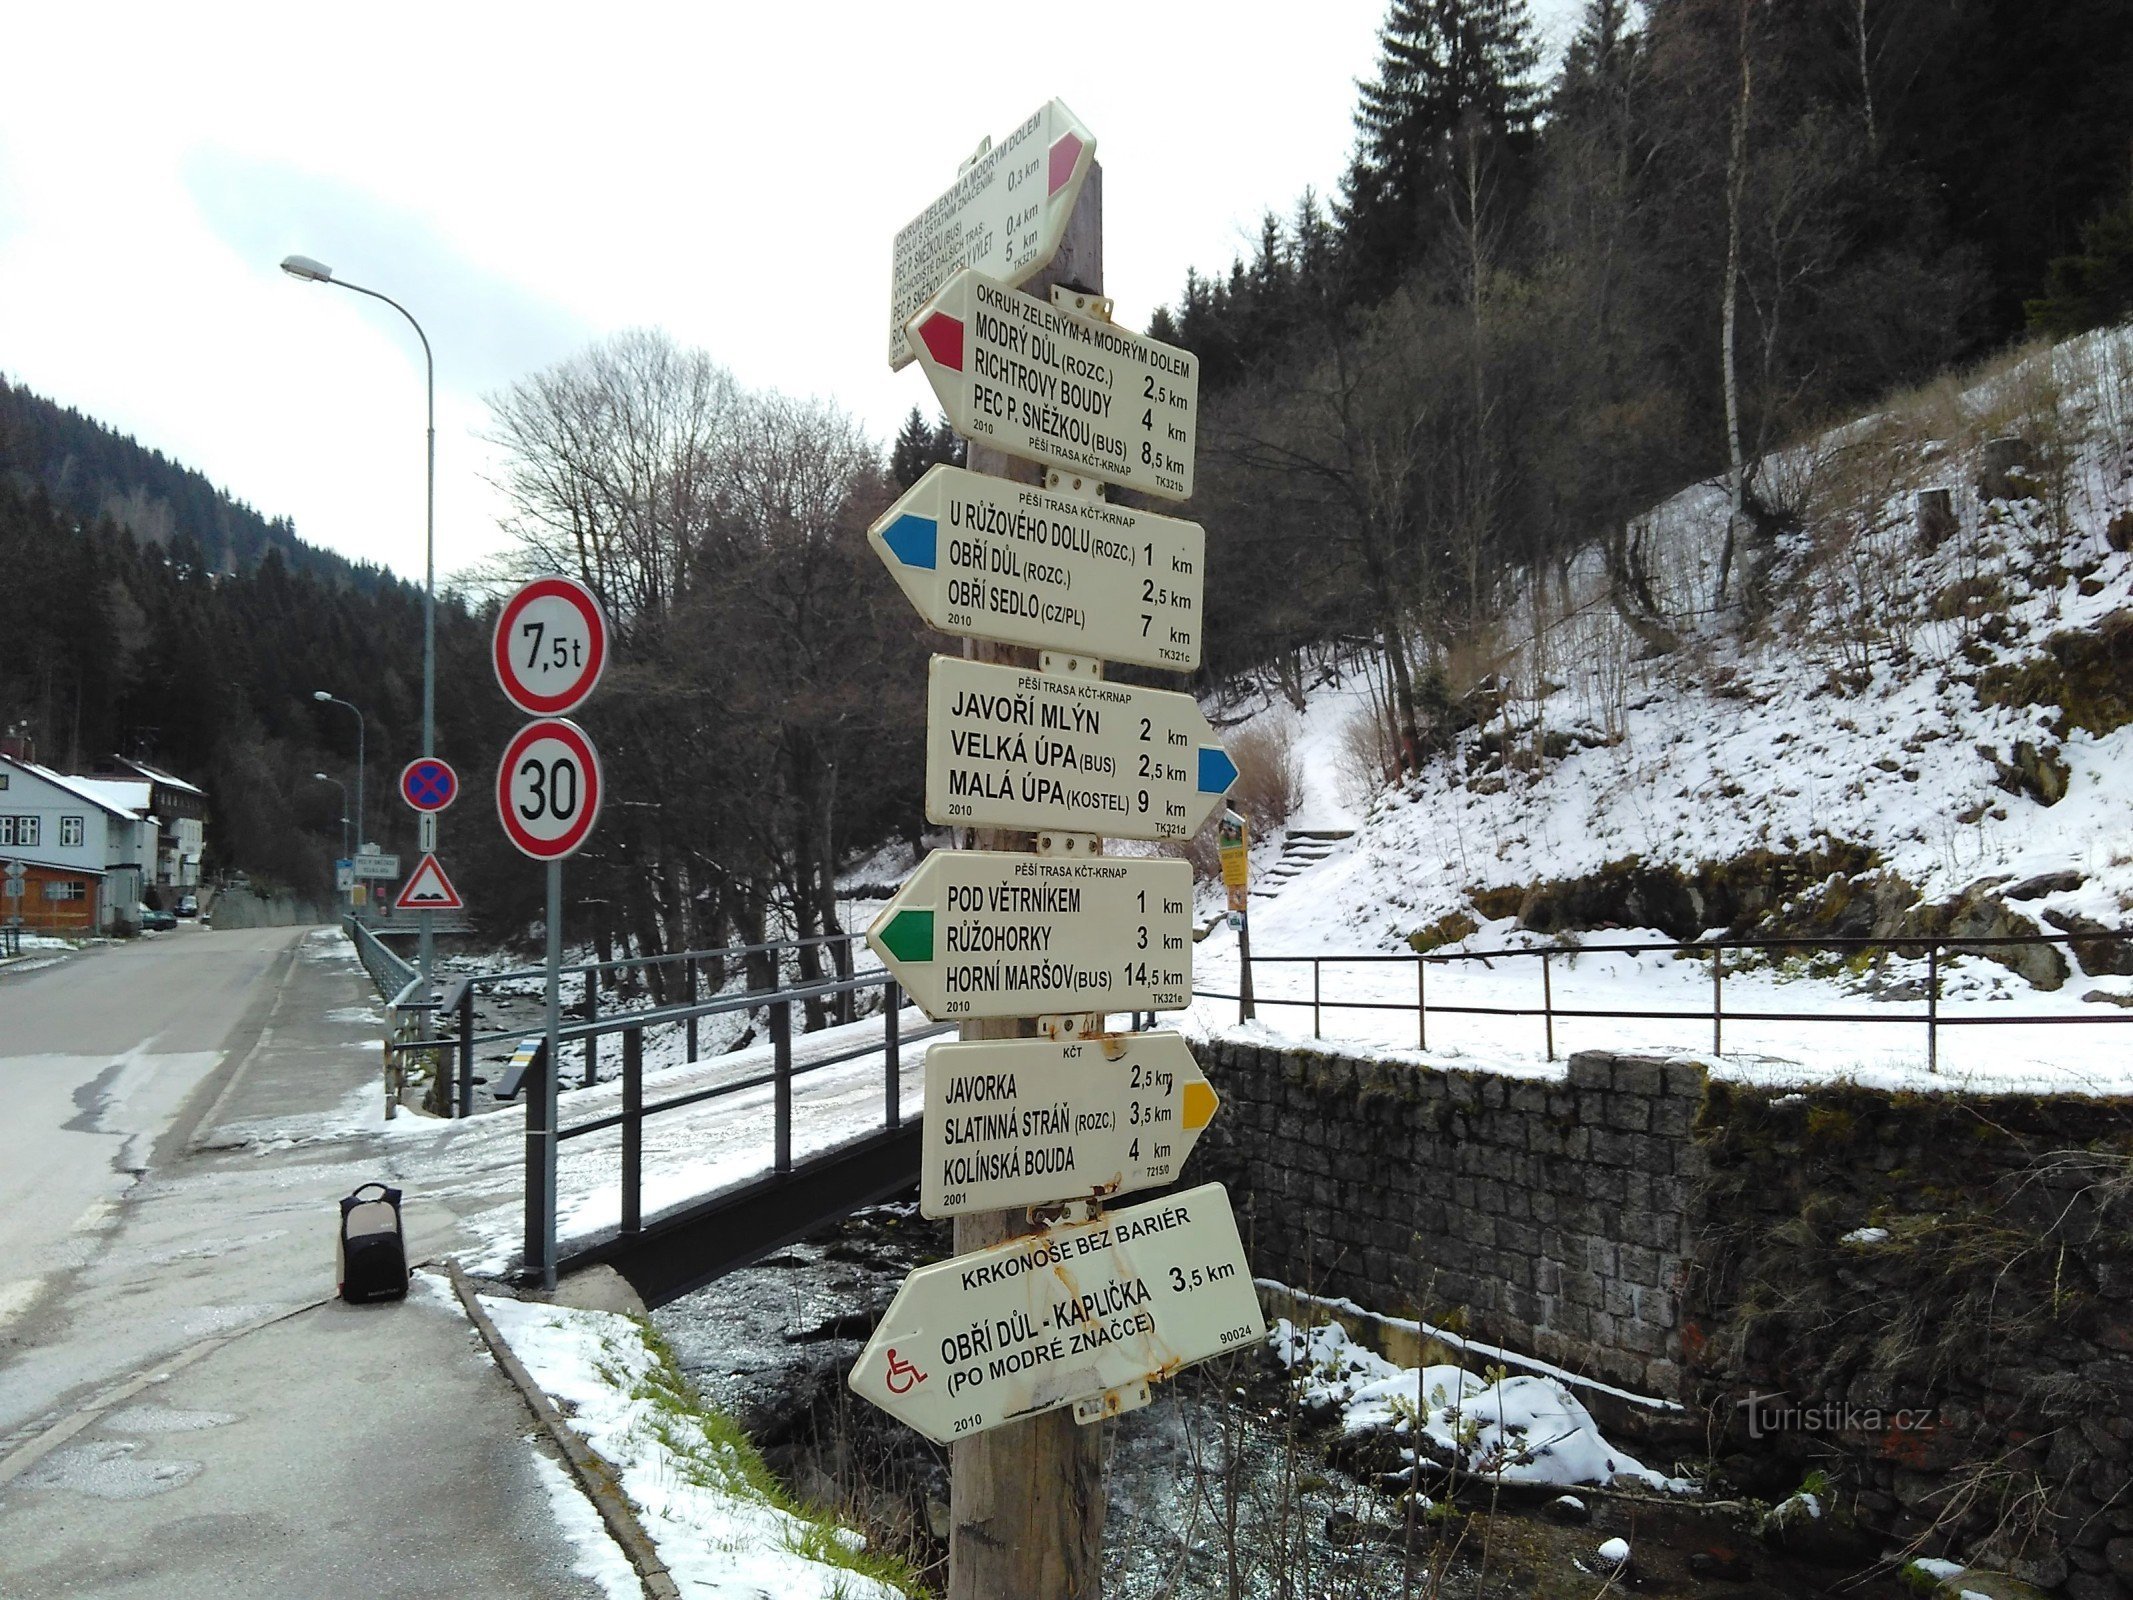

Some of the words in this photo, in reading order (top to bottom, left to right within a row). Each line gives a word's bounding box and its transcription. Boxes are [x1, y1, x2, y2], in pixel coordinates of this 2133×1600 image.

[962, 177, 968, 192] A
[1009, 111, 1041, 151] DOLEM
[1026, 158, 1039, 178] km
[1024, 204, 1038, 223] km
[1006, 240, 1013, 262] 5
[1024, 230, 1037, 250] km
[977, 284, 1020, 320] OKRUH
[1094, 331, 1147, 363] MODRÝM
[1151, 351, 1189, 378] DOLEM
[976, 311, 1027, 350] MODRÝ
[1032, 334, 1059, 368] DŮL
[1062, 354, 1113, 389] (ROZC.)
[1144, 375, 1165, 402] 2,5
[1169, 390, 1188, 410] km
[975, 348, 1057, 399] RICHTROVY
[1062, 381, 1111, 417] BOUDY
[1142, 409, 1152, 431] 4
[1168, 424, 1186, 442] km
[974, 419, 993, 434] 2010
[975, 384, 1002, 416] PEC
[1008, 396, 1018, 423] P.
[1023, 402, 1089, 446] SNĚŽKOU
[1092, 433, 1127, 461] (BUS)
[1142, 441, 1162, 469] 8,5
[1167, 456, 1184, 474] km
[1029, 436, 1048, 451] PĚŠÍ
[1051, 443, 1080, 462] TRASA
[1082, 454, 1131, 476] KČT-KRNAP
[1156, 476, 1183, 492] TK321b
[1019, 493, 1042, 508] PĚŠÍ
[1044, 499, 1078, 515] TRASA
[1080, 505, 1135, 528] KČT-KRNAP
[951, 500, 960, 526] U
[966, 501, 1047, 544] RŮŽOVÉHO
[1052, 523, 1090, 553] DOLU
[1092, 538, 1135, 566] (ROZC.)
[1144, 543, 1152, 566] 1
[1172, 556, 1192, 574] km
[950, 538, 987, 571] OBŘÍ
[992, 545, 1020, 577] DŮL
[1024, 561, 1070, 590] (ROZC.)
[1142, 579, 1166, 605] 2,5
[1171, 591, 1191, 609] km
[948, 613, 971, 627] 2010
[949, 578, 985, 610] OBŘÍ
[990, 587, 1038, 619] SEDLO
[1041, 603, 1085, 630] (CZ/PL)
[1141, 615, 1152, 637] 7
[1170, 627, 1190, 644] km
[1159, 648, 1189, 662] TK321c
[1019, 677, 1040, 690] PĚŠÍ
[1044, 681, 1076, 696] TRASA
[1078, 686, 1131, 704] KČT-KRNAP
[952, 691, 1033, 726] JAVOŘÍ
[1041, 702, 1099, 734] MLÝN
[1140, 718, 1150, 740] 2
[1168, 729, 1187, 746] km
[951, 729, 1027, 764] VELKÁ
[1035, 735, 1076, 769] ÚPA
[1080, 753, 1116, 777] (BUS)
[1139, 754, 1162, 781] 2,5
[1167, 765, 1186, 782] km
[520, 758, 576, 820] 30
[950, 769, 1014, 800] MALÁ
[1022, 772, 1064, 804] ÚPA
[1067, 789, 1129, 815] (KOSTEL)
[1138, 790, 1149, 812] 9
[1166, 800, 1185, 818] km
[949, 804, 971, 816] 2010
[1155, 822, 1186, 835] TK321d
[1015, 865, 1037, 876] PĚŠÍ
[1040, 866, 1072, 877] TRASA
[1075, 865, 1127, 879] KČT-KRNAP
[948, 886, 983, 912] POD
[989, 881, 1080, 912] VĚTRNÍKEM
[1137, 890, 1145, 913] 1
[1164, 899, 1182, 913] km
[948, 920, 1051, 951] RŮŽOHORKY
[1137, 926, 1147, 949] 3
[1164, 934, 1182, 949] km
[946, 960, 1000, 992] HORNÍ
[1124, 963, 1159, 988] 14,5
[1164, 970, 1182, 984] km
[946, 1001, 970, 1012] 2010
[1152, 994, 1182, 1003] TK321e
[1063, 1046, 1082, 1058] KČT
[946, 1074, 1017, 1104] JAVORKA
[1131, 1065, 1152, 1089] 2,5
[1156, 1070, 1173, 1087] km
[945, 1107, 1018, 1144] SLATINNÁ
[1022, 1103, 1069, 1140] STRÁŇ
[1075, 1111, 1115, 1135] (ROZC.)
[1130, 1101, 1151, 1126] 3,5
[1154, 1107, 1171, 1122] km
[944, 1146, 1020, 1186] KOLÍNSKÁ
[1025, 1146, 1075, 1175] BOUDA
[1129, 1138, 1139, 1161] 4
[1154, 1142, 1170, 1158] km
[944, 1193, 966, 1206] 2001
[961, 1242, 1074, 1291] KRKONOŠE
[1075, 1230, 1112, 1255] BEZ
[1116, 1207, 1191, 1245] BARIÉR
[941, 1318, 993, 1365] OBŘÍ
[996, 1310, 1038, 1346] DŮL
[1053, 1277, 1152, 1330] KAPLIČKA
[1169, 1266, 1203, 1293] 3,5
[1206, 1263, 1235, 1283] km
[1220, 1325, 1252, 1344] 90024
[947, 1365, 983, 1398] (PO
[989, 1338, 1066, 1381] MODRÉ
[1069, 1313, 1156, 1355] ZNAČCE)
[954, 1413, 983, 1433] 2010
